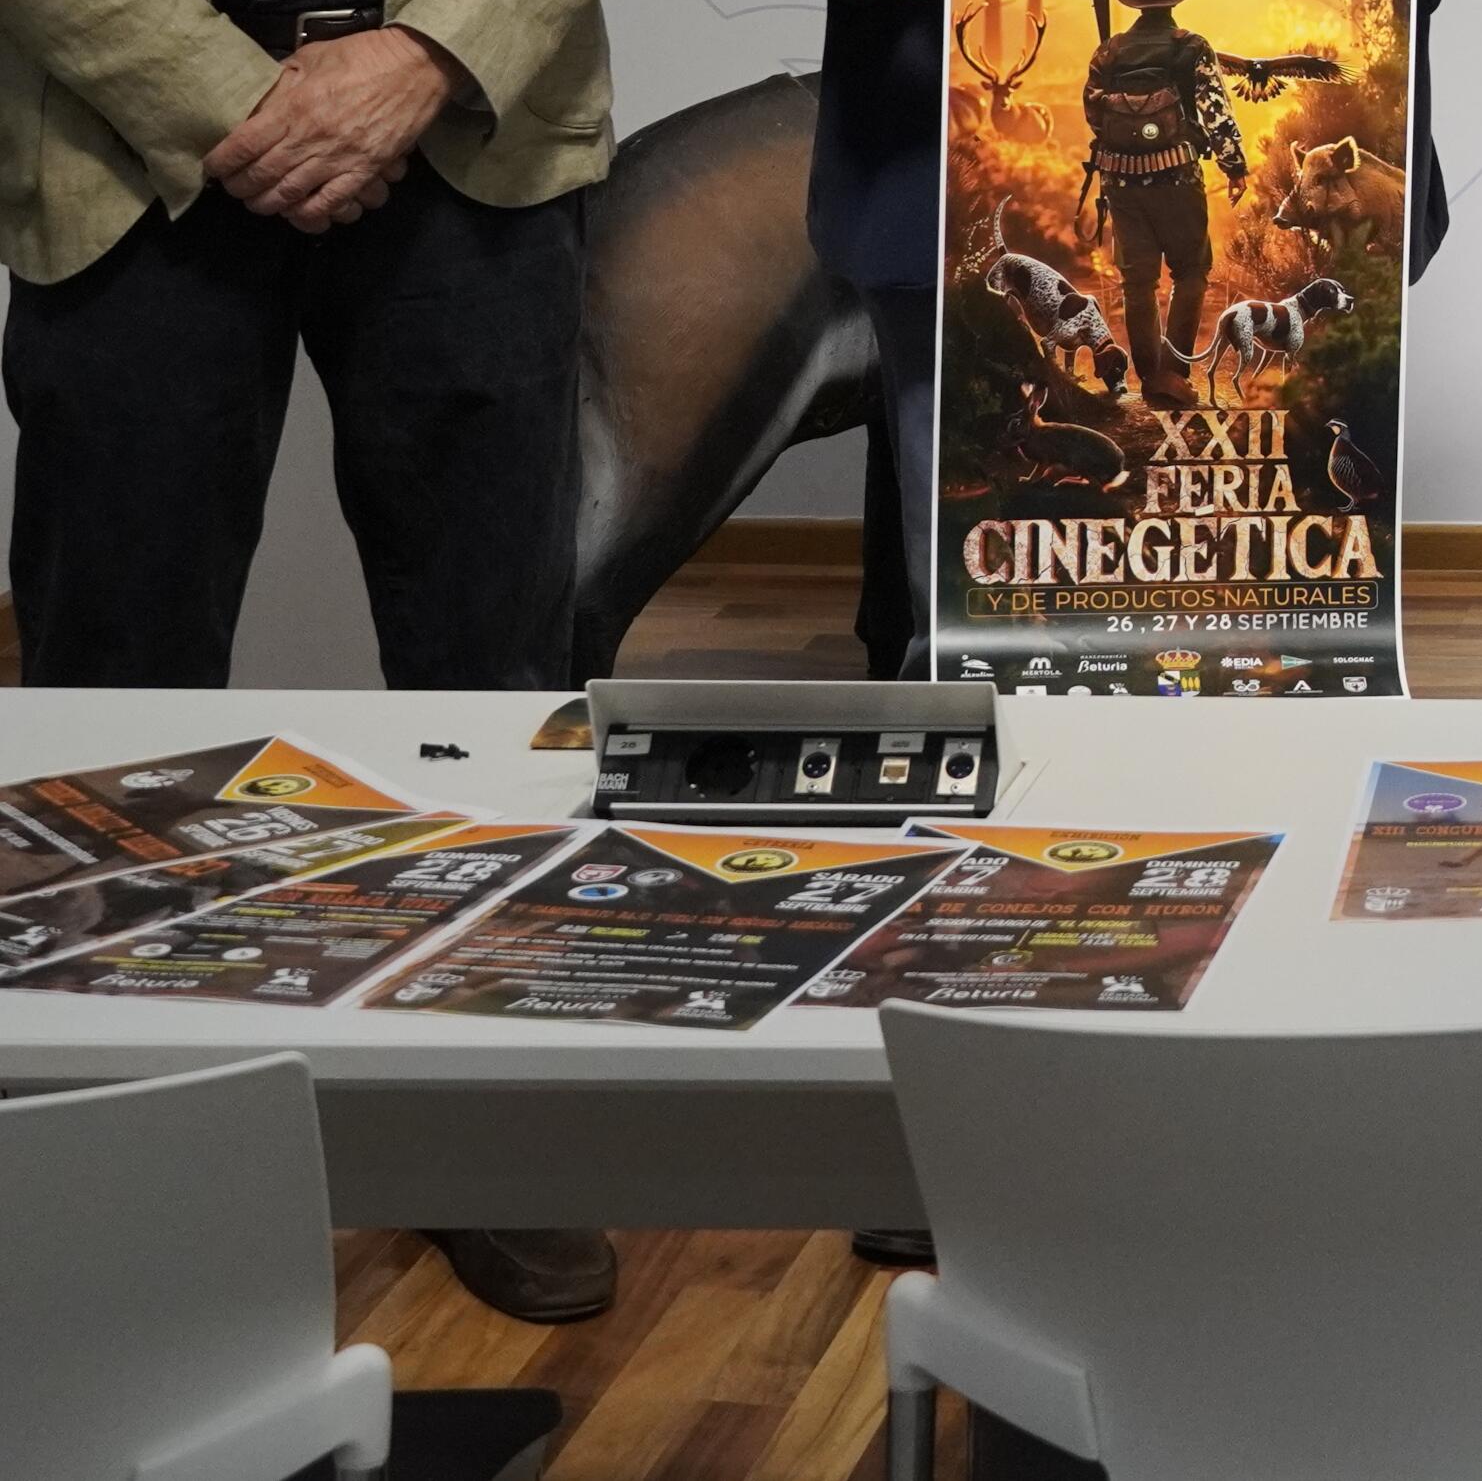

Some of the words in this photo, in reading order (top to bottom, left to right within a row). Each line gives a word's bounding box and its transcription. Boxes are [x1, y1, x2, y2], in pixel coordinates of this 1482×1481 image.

[1149, 408, 1290, 462] XXII
[1142, 464, 1302, 515] FERIA
[963, 505, 1384, 585] CINEGÉTICA
[986, 592, 1003, 612] Y
[1011, 591, 1048, 612] DE
[1055, 588, 1217, 610] PRODUCTOS
[1223, 585, 1371, 608] NATURALES
[1152, 614, 1178, 632] 27
[1184, 614, 1199, 631] Y
[1205, 613, 1232, 631] 28
[1237, 611, 1369, 631] SEPTIEMBRE
[1233, 656, 1264, 668] EDIA
[1333, 656, 1375, 664] SOLOGNAC
[599, 772, 629, 781] BACH
[202, 811, 293, 841] 26
[423, 851, 523, 863] DOMINGO
[1145, 860, 1241, 868] DOMINGO
[394, 859, 503, 882] 28
[810, 870, 905, 885] SÁBADO
[1133, 867, 1233, 888] 28
[786, 880, 896, 904] 27
[1128, 887, 1227, 897] SEPTIEMBRE
[774, 900, 872, 914] SEPTIEMBRE
[935, 902, 968, 913] DE
[976, 903, 1078, 915] CONEJOS
[1086, 904, 1134, 915] CON
